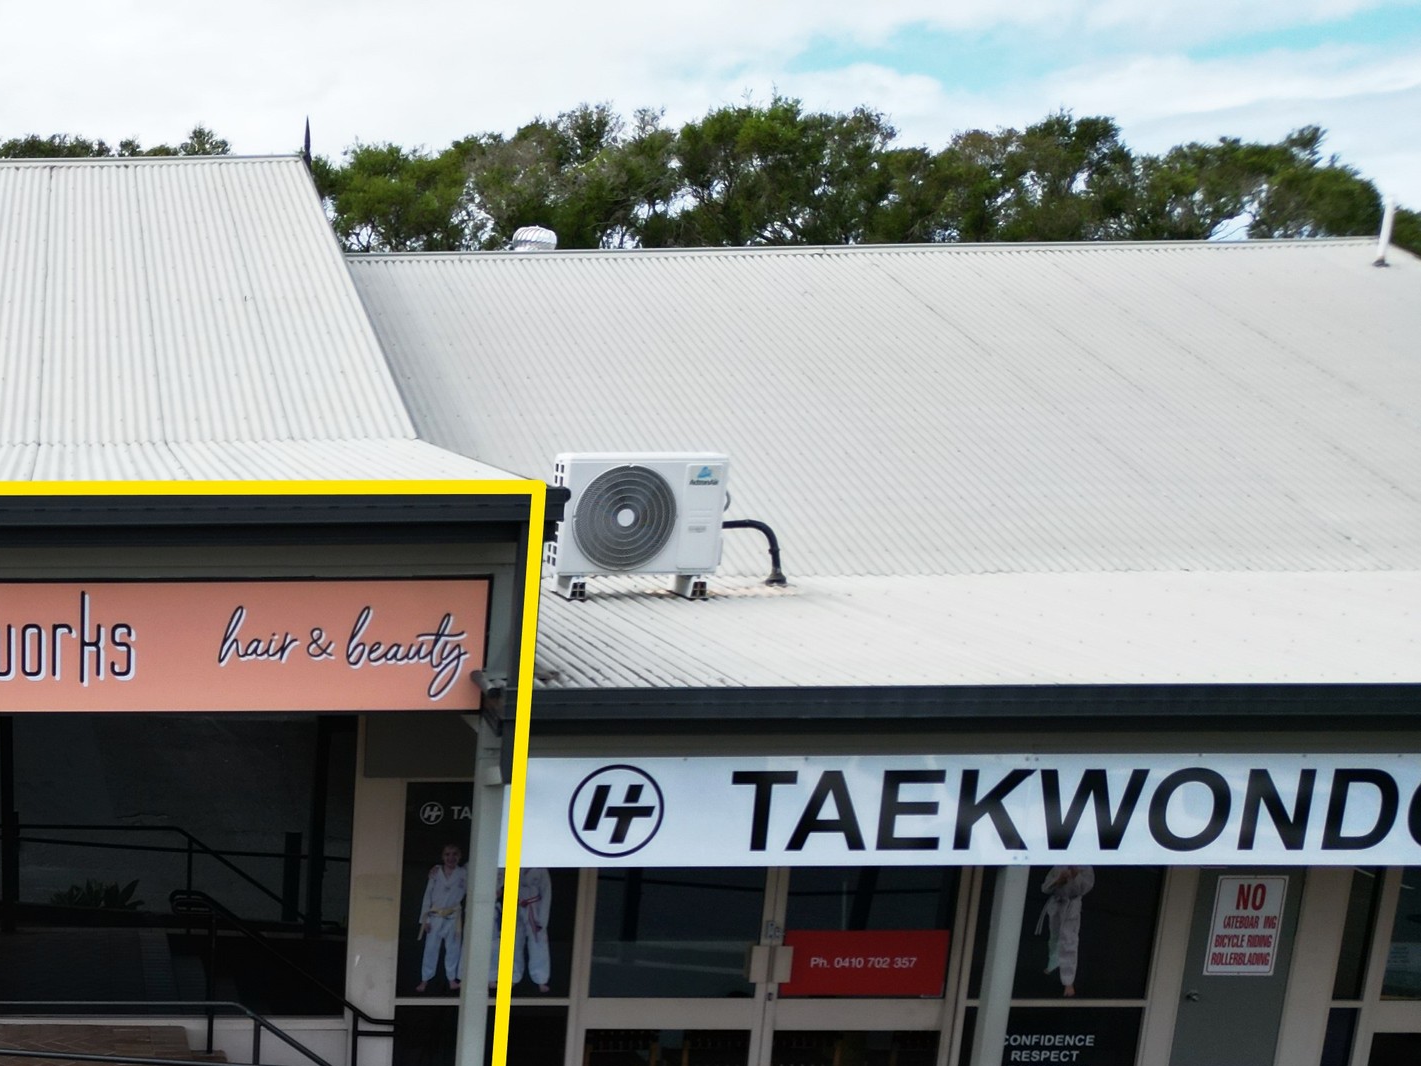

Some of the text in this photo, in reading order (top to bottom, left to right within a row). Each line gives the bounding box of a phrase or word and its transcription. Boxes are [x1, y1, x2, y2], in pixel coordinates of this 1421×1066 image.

[218, 605, 470, 701] hair & beauty
[731, 767, 1421, 852] TAEKWOND
[1235, 883, 1267, 911] NO
[1214, 934, 1273, 948] BICYCLE RIDING
[810, 957, 918, 968] Ph. 0410 702 357
[1210, 951, 1270, 966] ROLLERBLADING
[1010, 1050, 1079, 1062] RESPECT
